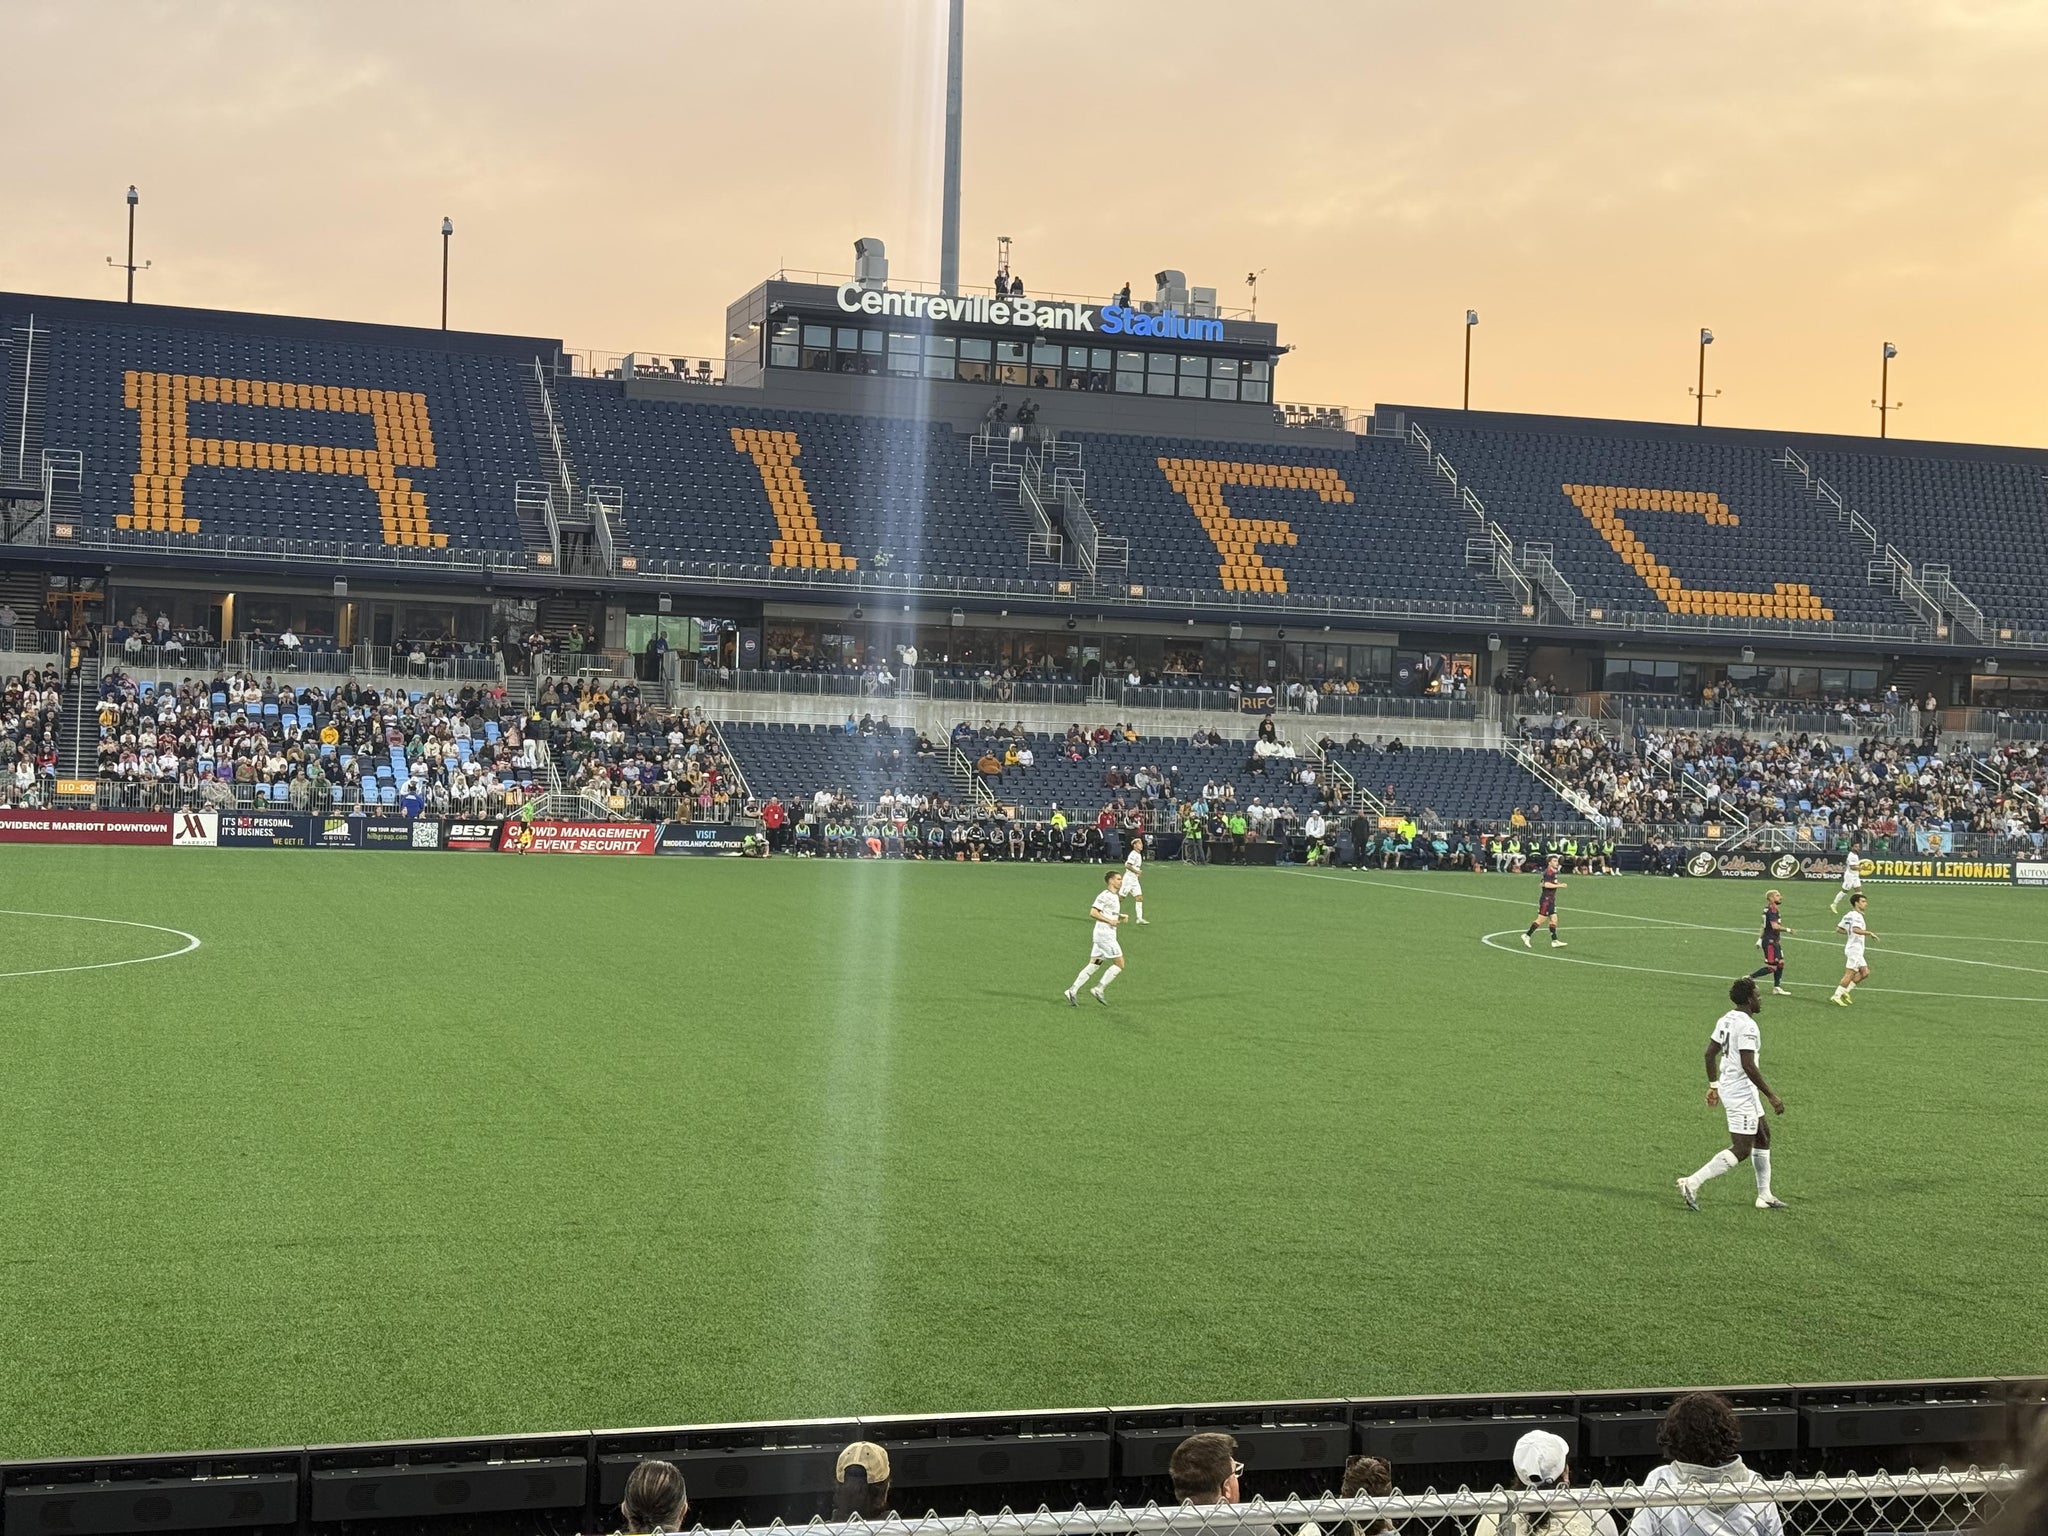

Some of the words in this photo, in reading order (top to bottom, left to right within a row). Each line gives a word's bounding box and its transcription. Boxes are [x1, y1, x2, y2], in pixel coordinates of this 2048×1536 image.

[836, 282, 1010, 325] Centreville
[1013, 297, 1094, 331] Bank
[1101, 304, 1223, 341] Stadium
[1242, 696, 1275, 709] RIFC
[52, 822, 104, 831] MARRIOTT
[107, 824, 167, 832] DOWNTOWN
[222, 817, 236, 826] IT'S
[254, 818, 294, 828] PERSONAL,
[221, 827, 236, 836] IT'S
[237, 828, 275, 837] BUSINESS.
[450, 825, 498, 836] BEST
[560, 827, 650, 838] MANAGEMENT
[695, 830, 717, 839] VISIT
[534, 839, 577, 850] EVENT
[579, 841, 641, 851] SECURITY
[1876, 860, 1932, 877] FROZEN
[1936, 862, 2011, 878] LEMONADE
